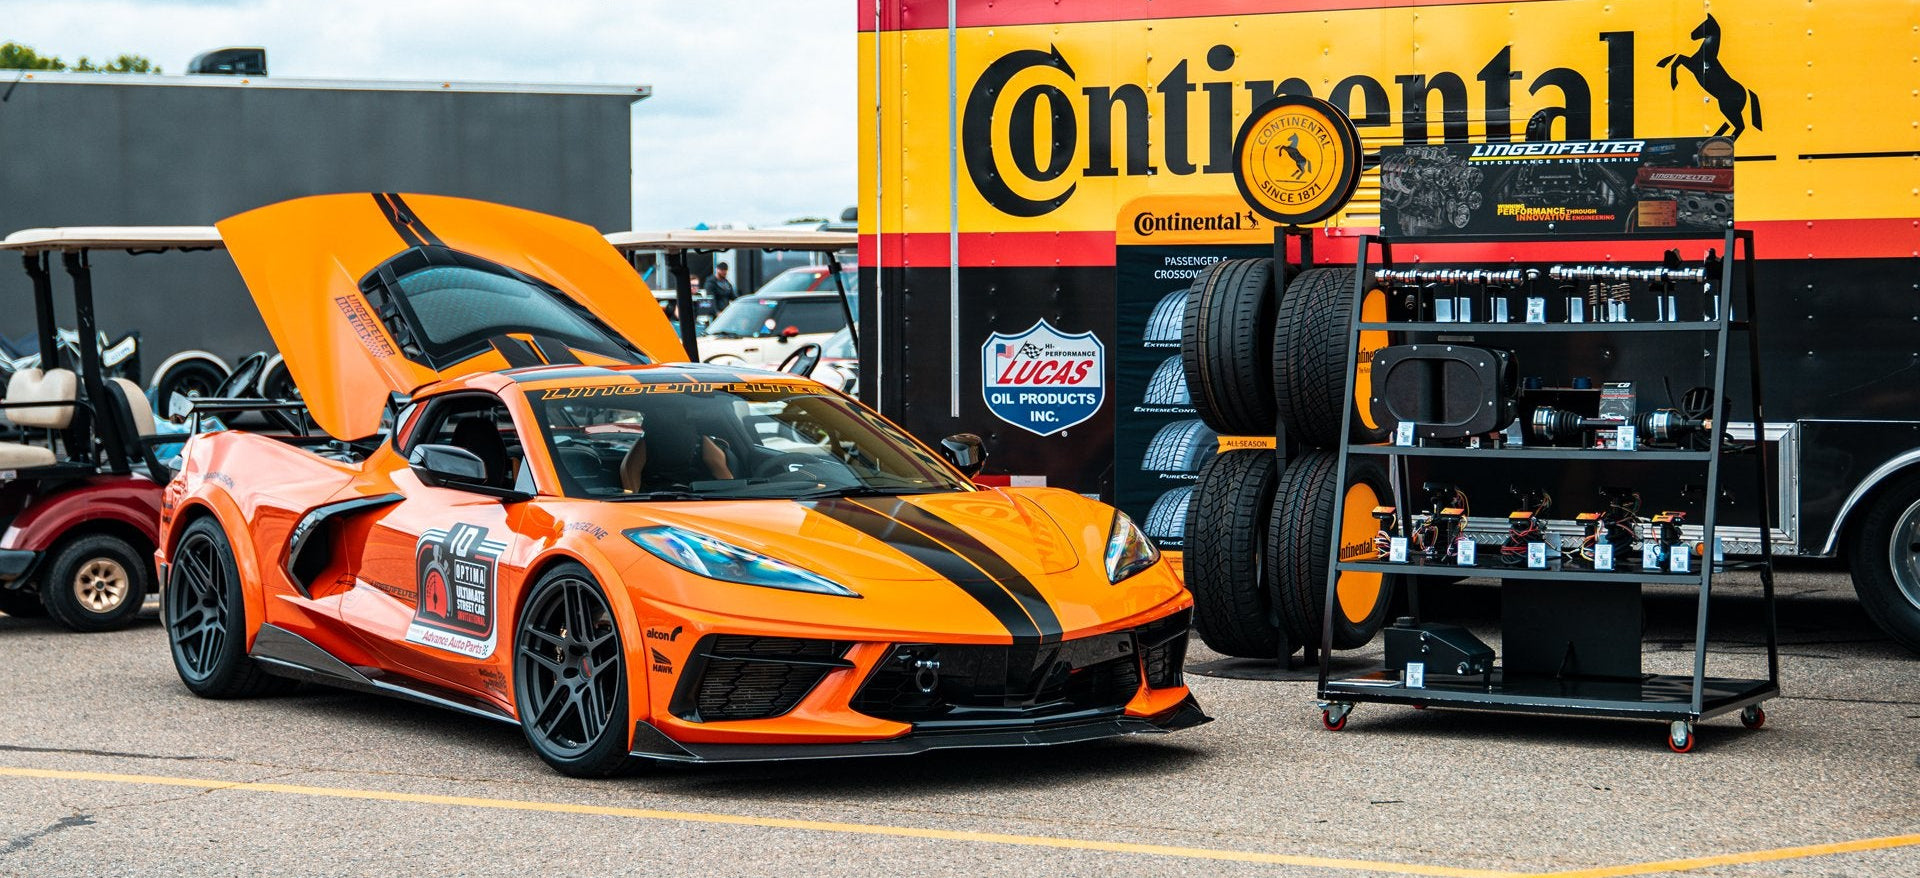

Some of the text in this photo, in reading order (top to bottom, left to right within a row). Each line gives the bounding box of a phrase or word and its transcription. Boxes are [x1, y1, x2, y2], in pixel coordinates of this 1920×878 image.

[1258, 116, 1331, 150] CONTINENTAL
[1472, 141, 1645, 157] LINGENFELTER
[1650, 173, 1716, 182] LINGENFELTER
[1261, 180, 1321, 203] SINCE 1871
[1497, 207, 1566, 216] PERFORMANCE
[1516, 213, 1571, 221] INNOVATIVE
[1134, 212, 1241, 237] Continental
[1165, 256, 1219, 266] PASSENGER
[1154, 269, 1202, 279] CROSSOV
[346, 294, 396, 356] LINGENFELTER
[996, 360, 1094, 385] LUCAS
[541, 382, 829, 400] LINGENFELTER
[991, 393, 1096, 405] OIL PRODUCTS
[1030, 410, 1059, 422] INC.
[1226, 440, 1267, 448] ALL-SEASON
[450, 524, 479, 558] 10
[1340, 537, 1373, 560] ntinental
[456, 563, 484, 585] OPTIMA
[456, 585, 485, 605] ULTIMATE
[457, 598, 486, 617] STREET CAR
[422, 630, 448, 646] Advance
[448, 637, 465, 650] Auto
[464, 640, 483, 654] Parts
[646, 628, 670, 641] alcon
[653, 663, 673, 675] HAWK
